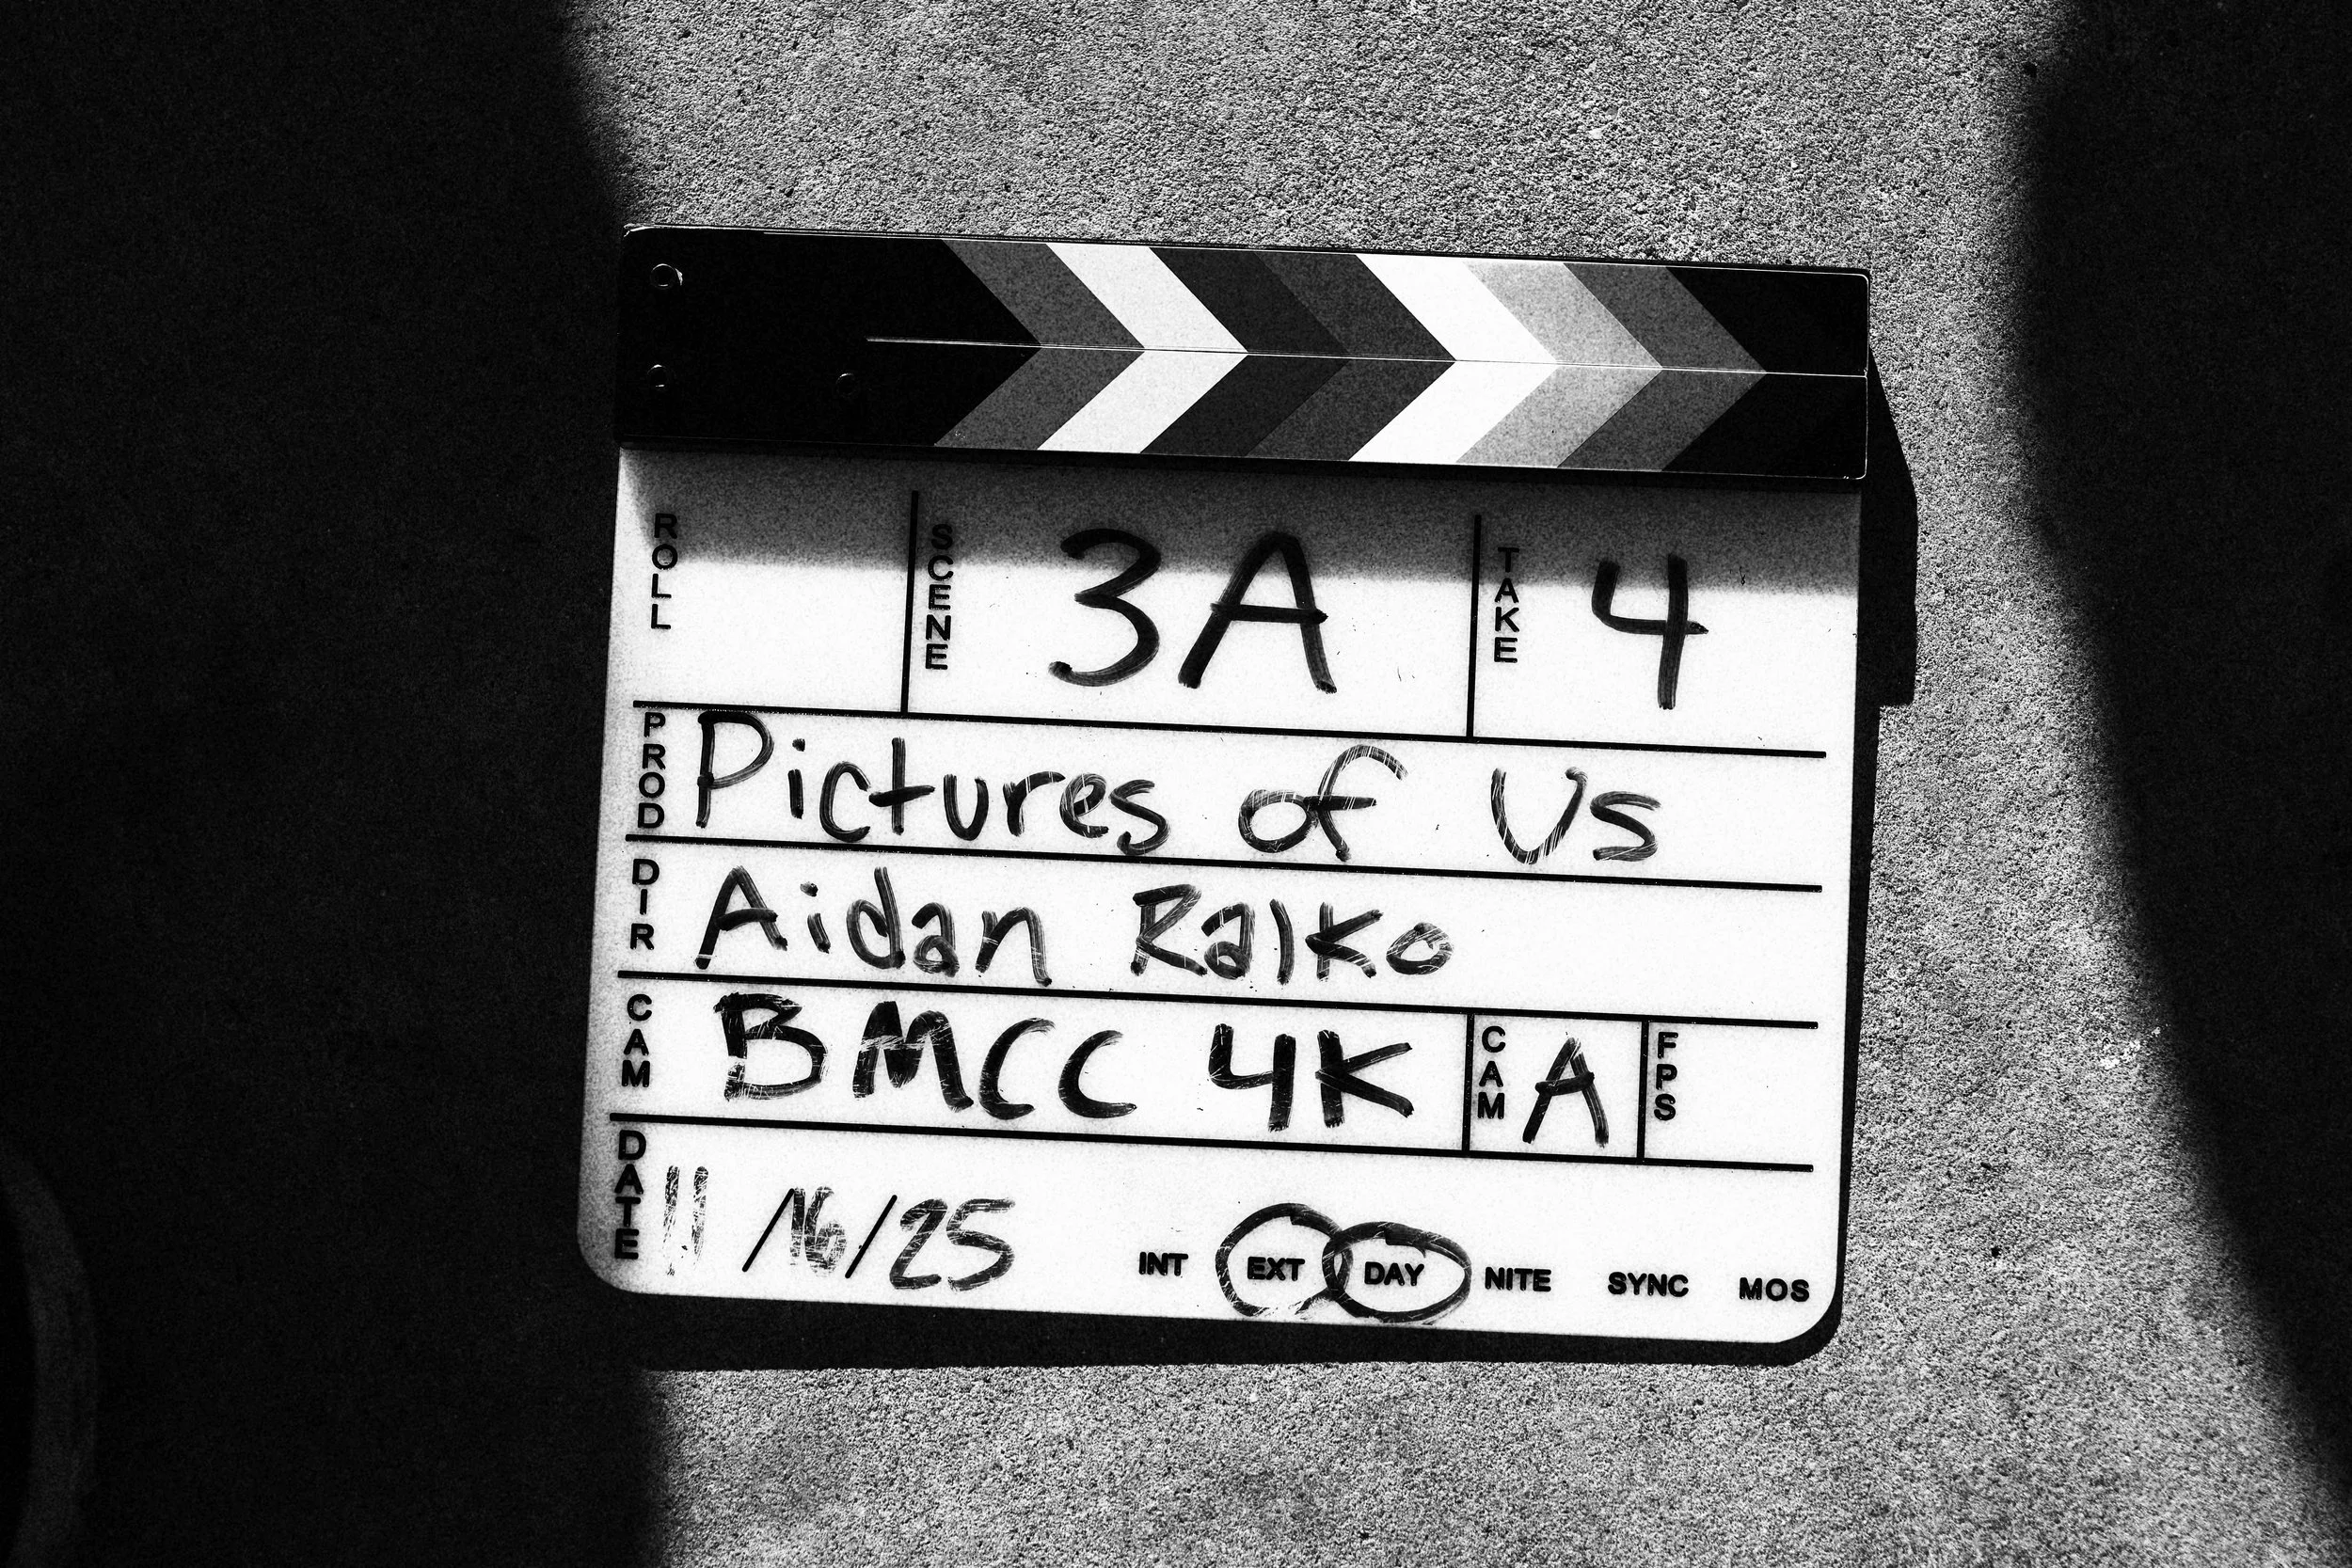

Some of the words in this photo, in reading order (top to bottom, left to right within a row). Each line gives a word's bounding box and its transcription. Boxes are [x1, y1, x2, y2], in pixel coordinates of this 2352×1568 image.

[651, 513, 678, 630] ROLL
[925, 523, 953, 671] SCENE
[1049, 528, 1338, 694] 3A
[1493, 546, 1520, 664] TAKE
[1591, 552, 1709, 710] 4
[637, 711, 667, 829] PROD
[695, 710, 1169, 856] Pictures
[1237, 744, 1408, 862] of
[1490, 767, 1661, 865] Us
[630, 858, 660, 951] DIR
[694, 865, 1053, 986] Aidan
[621, 993, 653, 1088] CAM
[712, 991, 1137, 1120] BMCC
[1207, 1022, 1414, 1132] 4K
[1476, 1025, 1507, 1120] CAM
[1521, 1036, 1611, 1148] A
[1653, 1031, 1680, 1122] FPS
[613, 1129, 648, 1261] DATE
[1137, 1251, 1189, 1277] INT
[1246, 1256, 1307, 1283] EXT
[1363, 1260, 1426, 1288] DAY
[1484, 1265, 1553, 1293] NITE
[1606, 1271, 1690, 1299] SYNC
[1738, 1276, 1811, 1304] MOS
